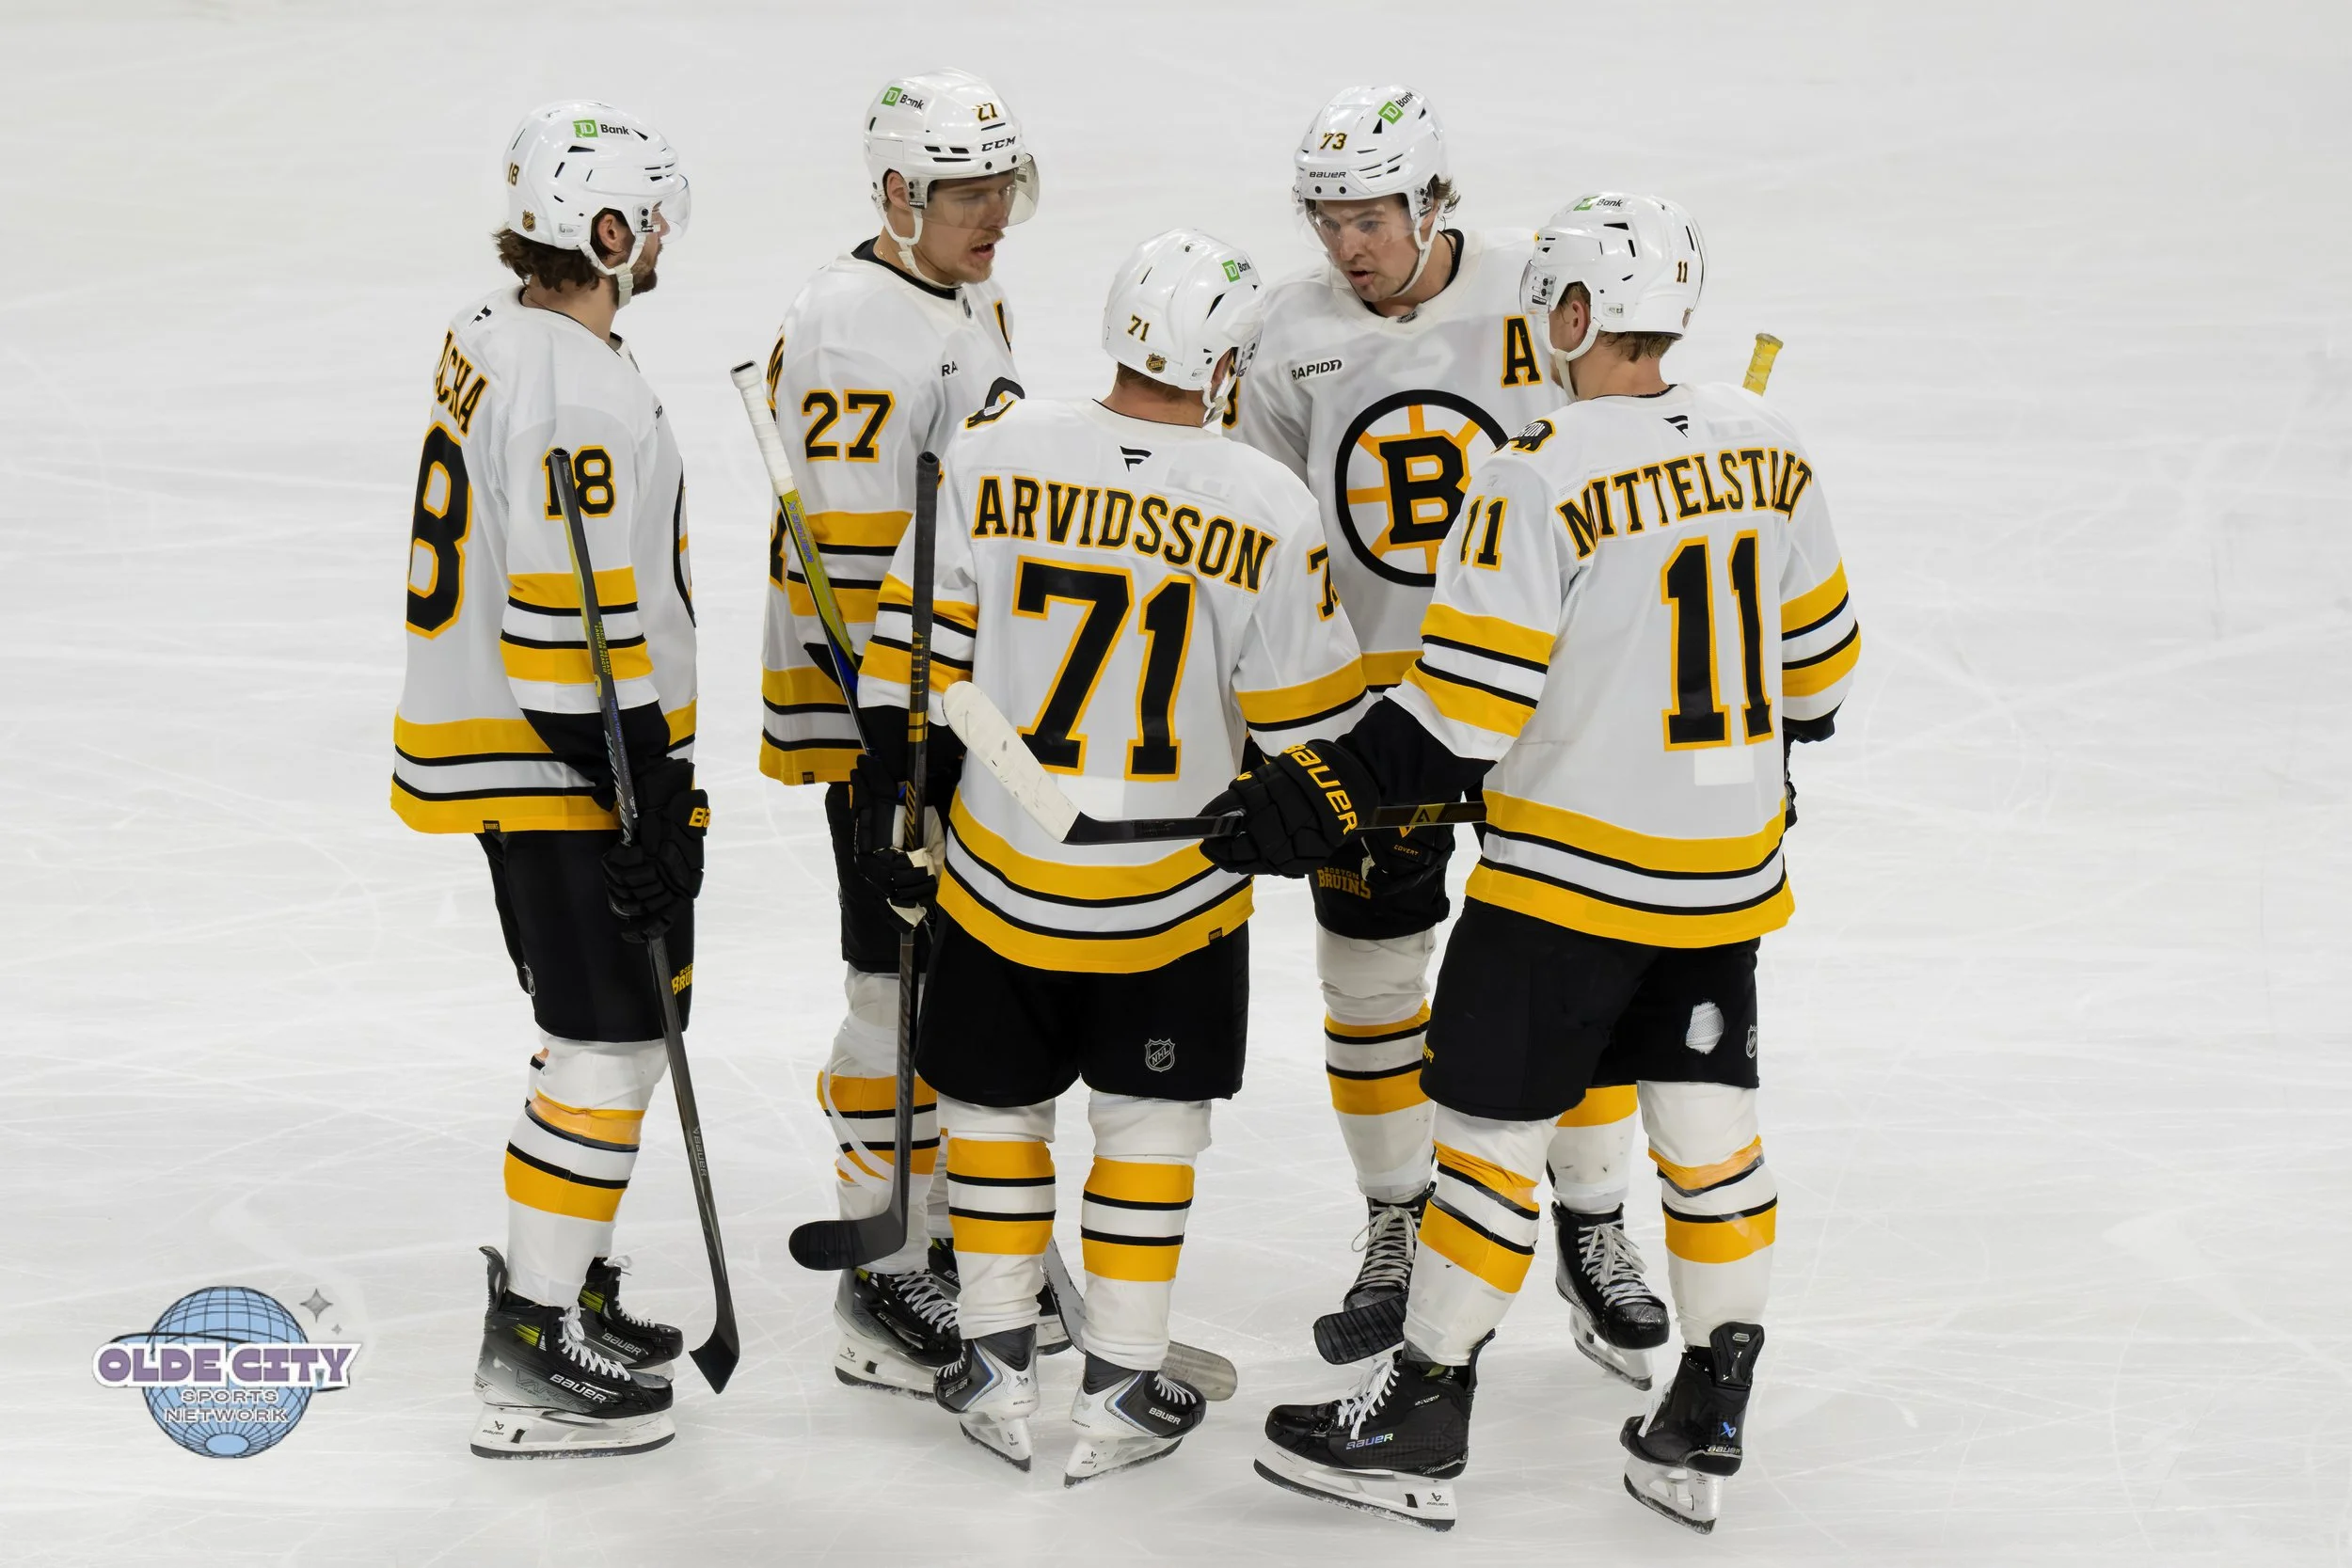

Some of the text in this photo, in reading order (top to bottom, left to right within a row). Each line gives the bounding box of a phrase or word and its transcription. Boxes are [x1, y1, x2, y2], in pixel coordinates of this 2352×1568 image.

[900, 95, 924, 110] Bank
[600, 124, 629, 135] Bank
[1319, 132, 1348, 151] 73
[981, 135, 1016, 151] CCM
[507, 162, 519, 186] 18
[1677, 261, 1688, 283] 11
[1127, 313, 1151, 342] 71
[1502, 315, 1542, 388] A
[802, 388, 896, 463] 27
[541, 444, 617, 521] 18
[972, 474, 1279, 594] ARVIDSSON
[1460, 495, 1508, 571] 11
[1661, 528, 1774, 752] 11
[1012, 554, 1199, 783] 71
[1393, 845, 1419, 856] COVERT
[1317, 869, 1372, 900] BRUINS
[1152, 1047, 1170, 1066] NHL
[601, 1332, 642, 1356] BAUER
[549, 1373, 609, 1404] BAUER
[1148, 1406, 1183, 1426] BAUER
[1345, 1433, 1394, 1450] BAUER
